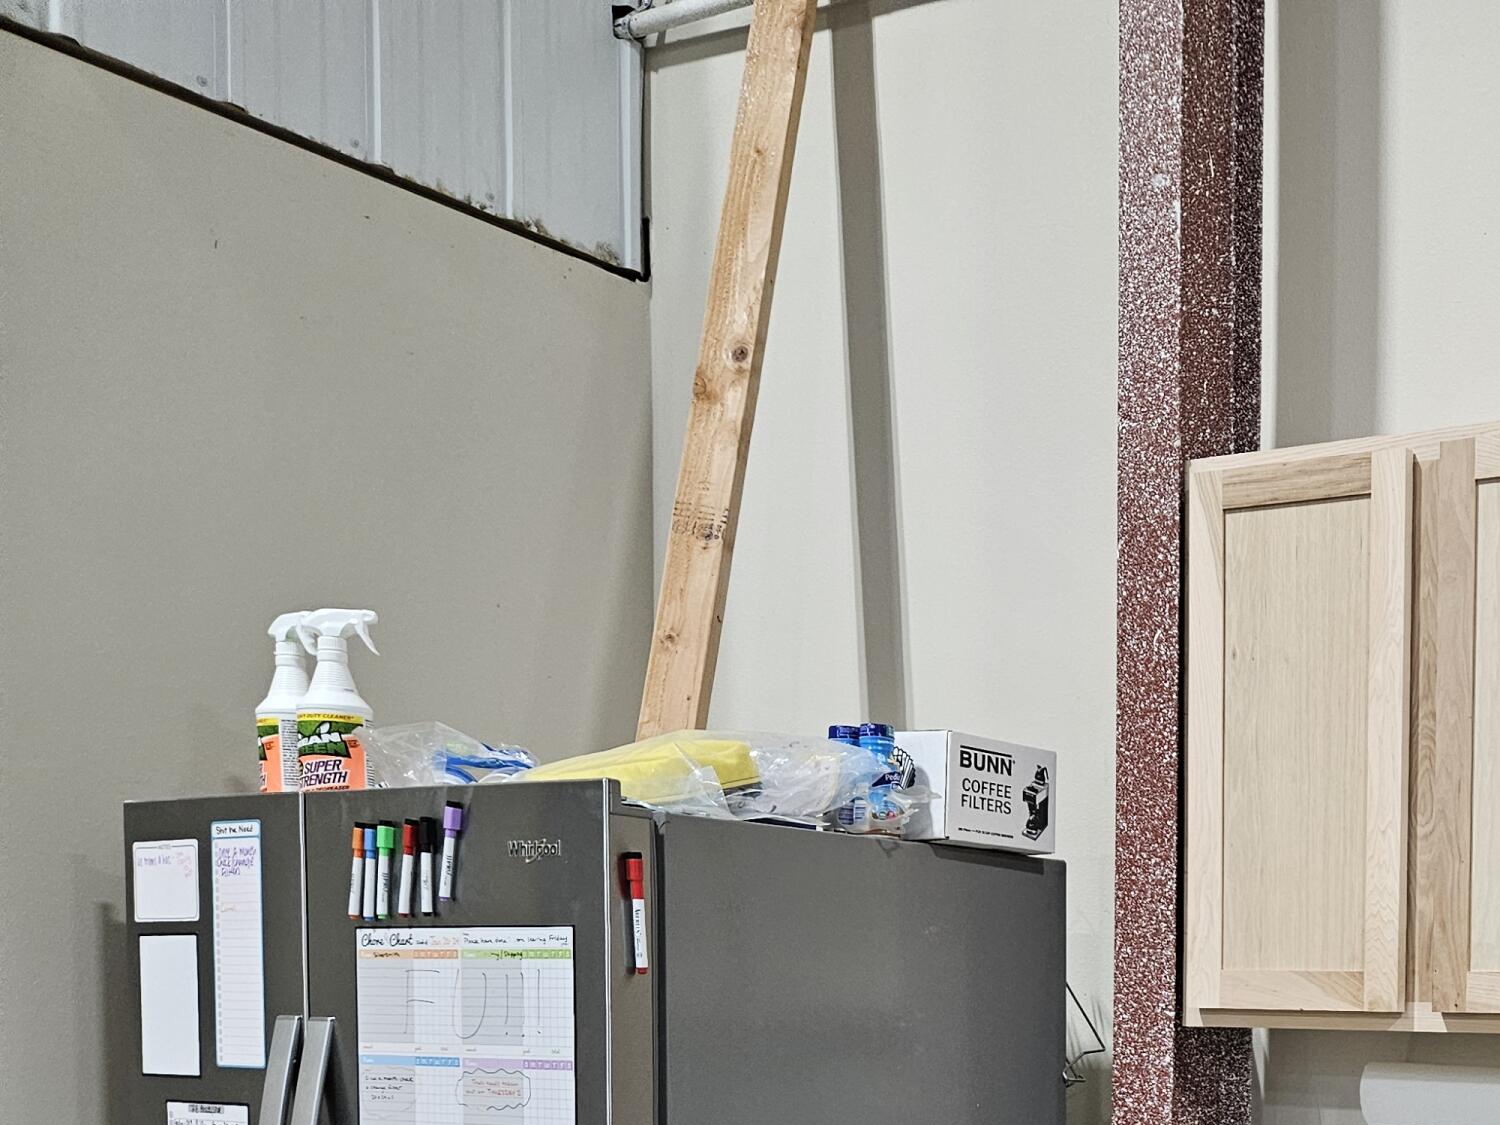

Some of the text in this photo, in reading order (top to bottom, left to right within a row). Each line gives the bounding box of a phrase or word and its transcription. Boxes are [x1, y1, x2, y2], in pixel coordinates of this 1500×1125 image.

[304, 759, 342, 775] SUPER
[960, 749, 1012, 777] BUNN
[962, 777, 1012, 800] COFFEE
[961, 793, 1012, 815] FILTERS
[507, 838, 561, 861] Whirlpool
